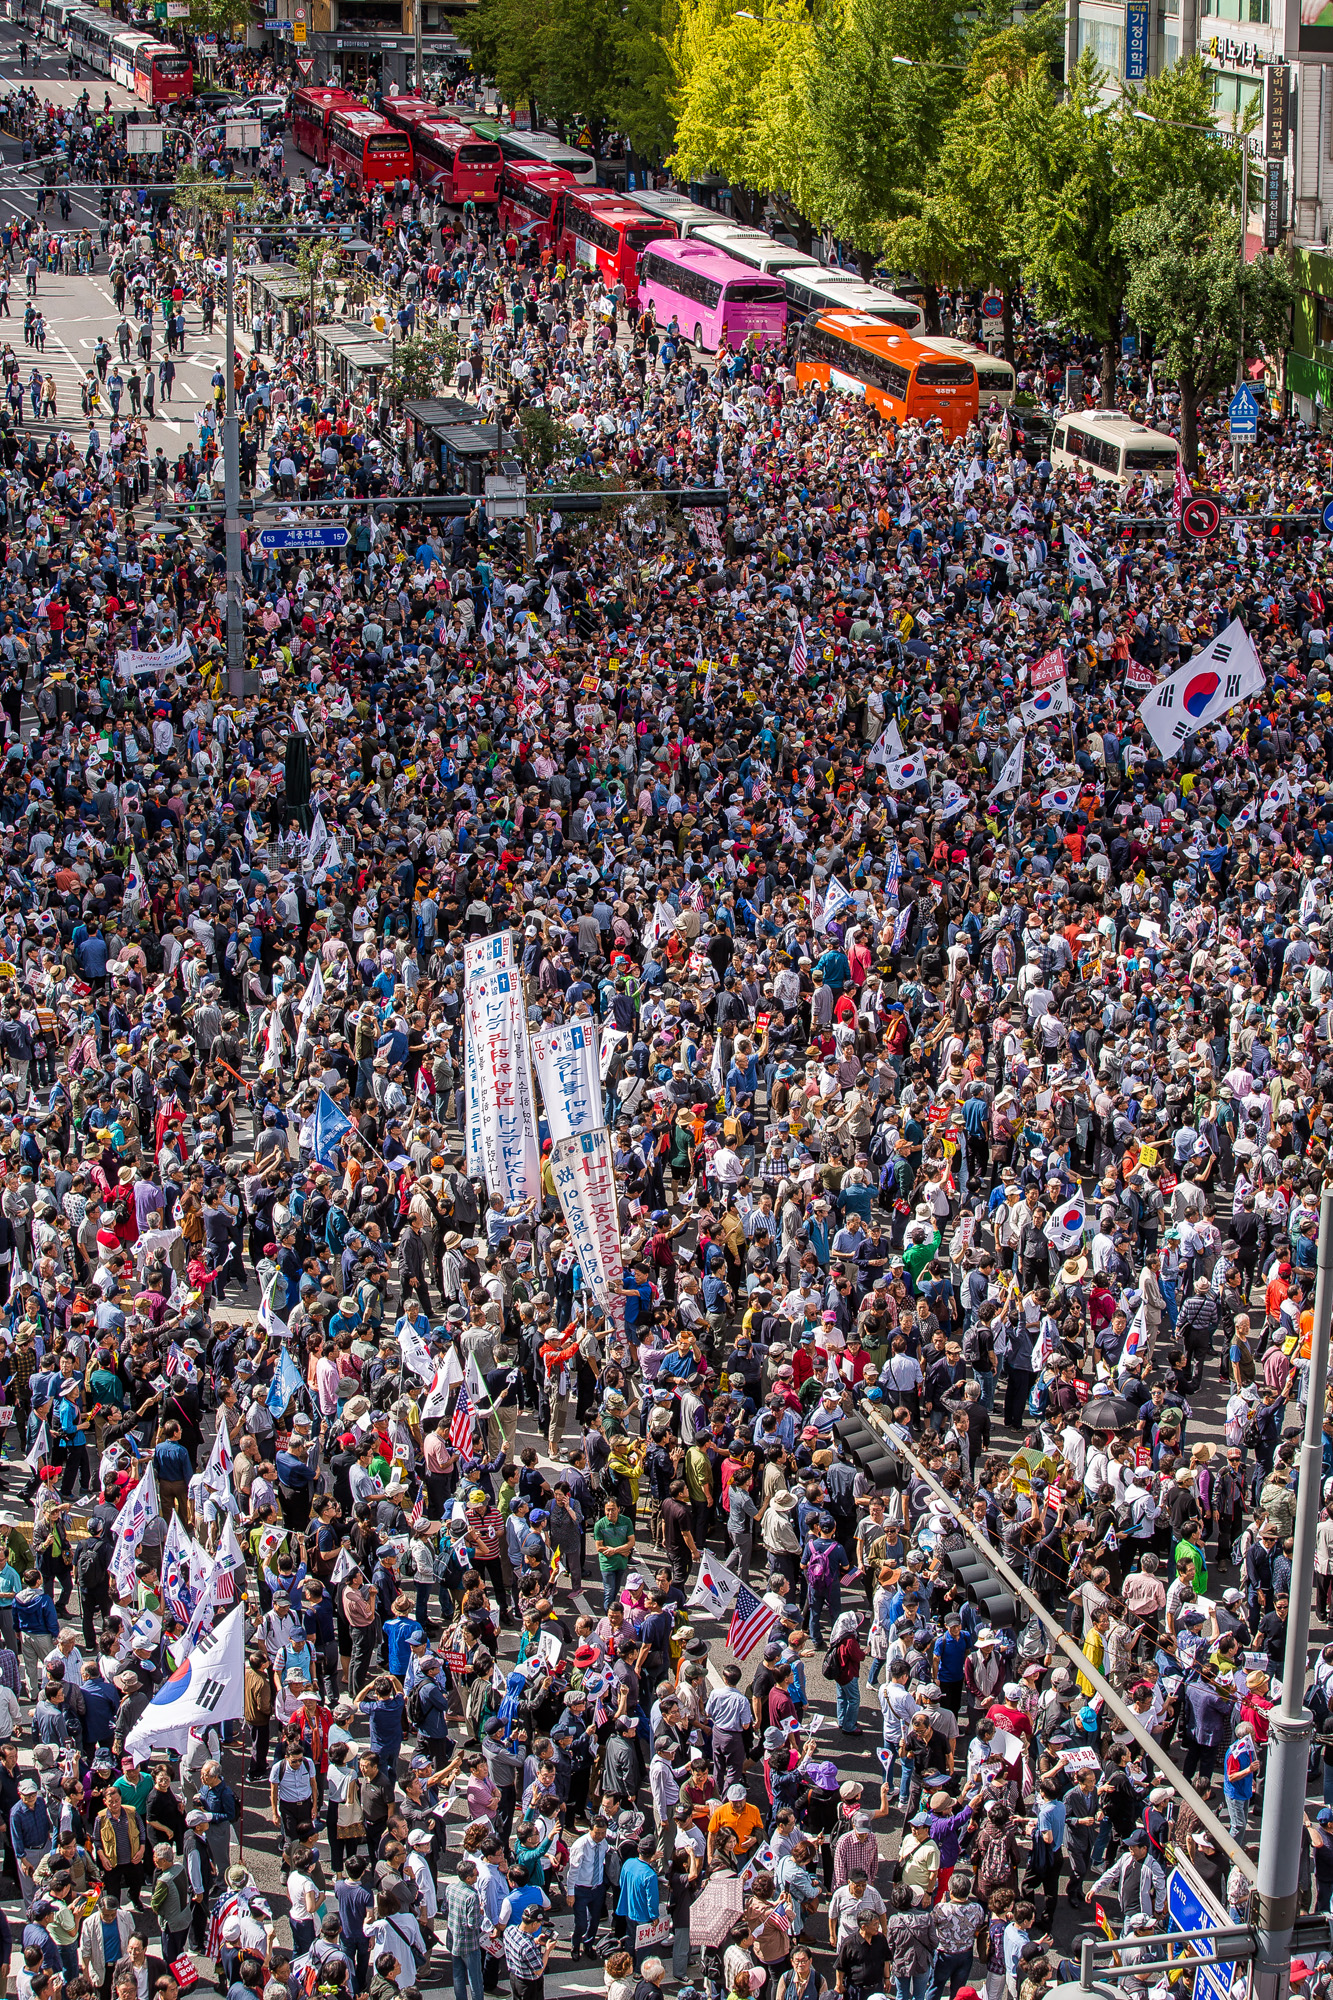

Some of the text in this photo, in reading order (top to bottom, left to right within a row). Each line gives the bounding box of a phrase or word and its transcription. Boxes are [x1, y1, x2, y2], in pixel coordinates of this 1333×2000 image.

[1130, 13, 1144, 77] 가정의학과
[1208, 36, 1257, 69] 강비뇨기과
[1272, 67, 1285, 116] 강비뇨기과
[1271, 120, 1283, 150] 피부과
[287, 530, 322, 539] 세종대로
[1081, 1750, 1097, 1762] 퇴진
[638, 1921, 669, 1941] 문재인 퇴진
